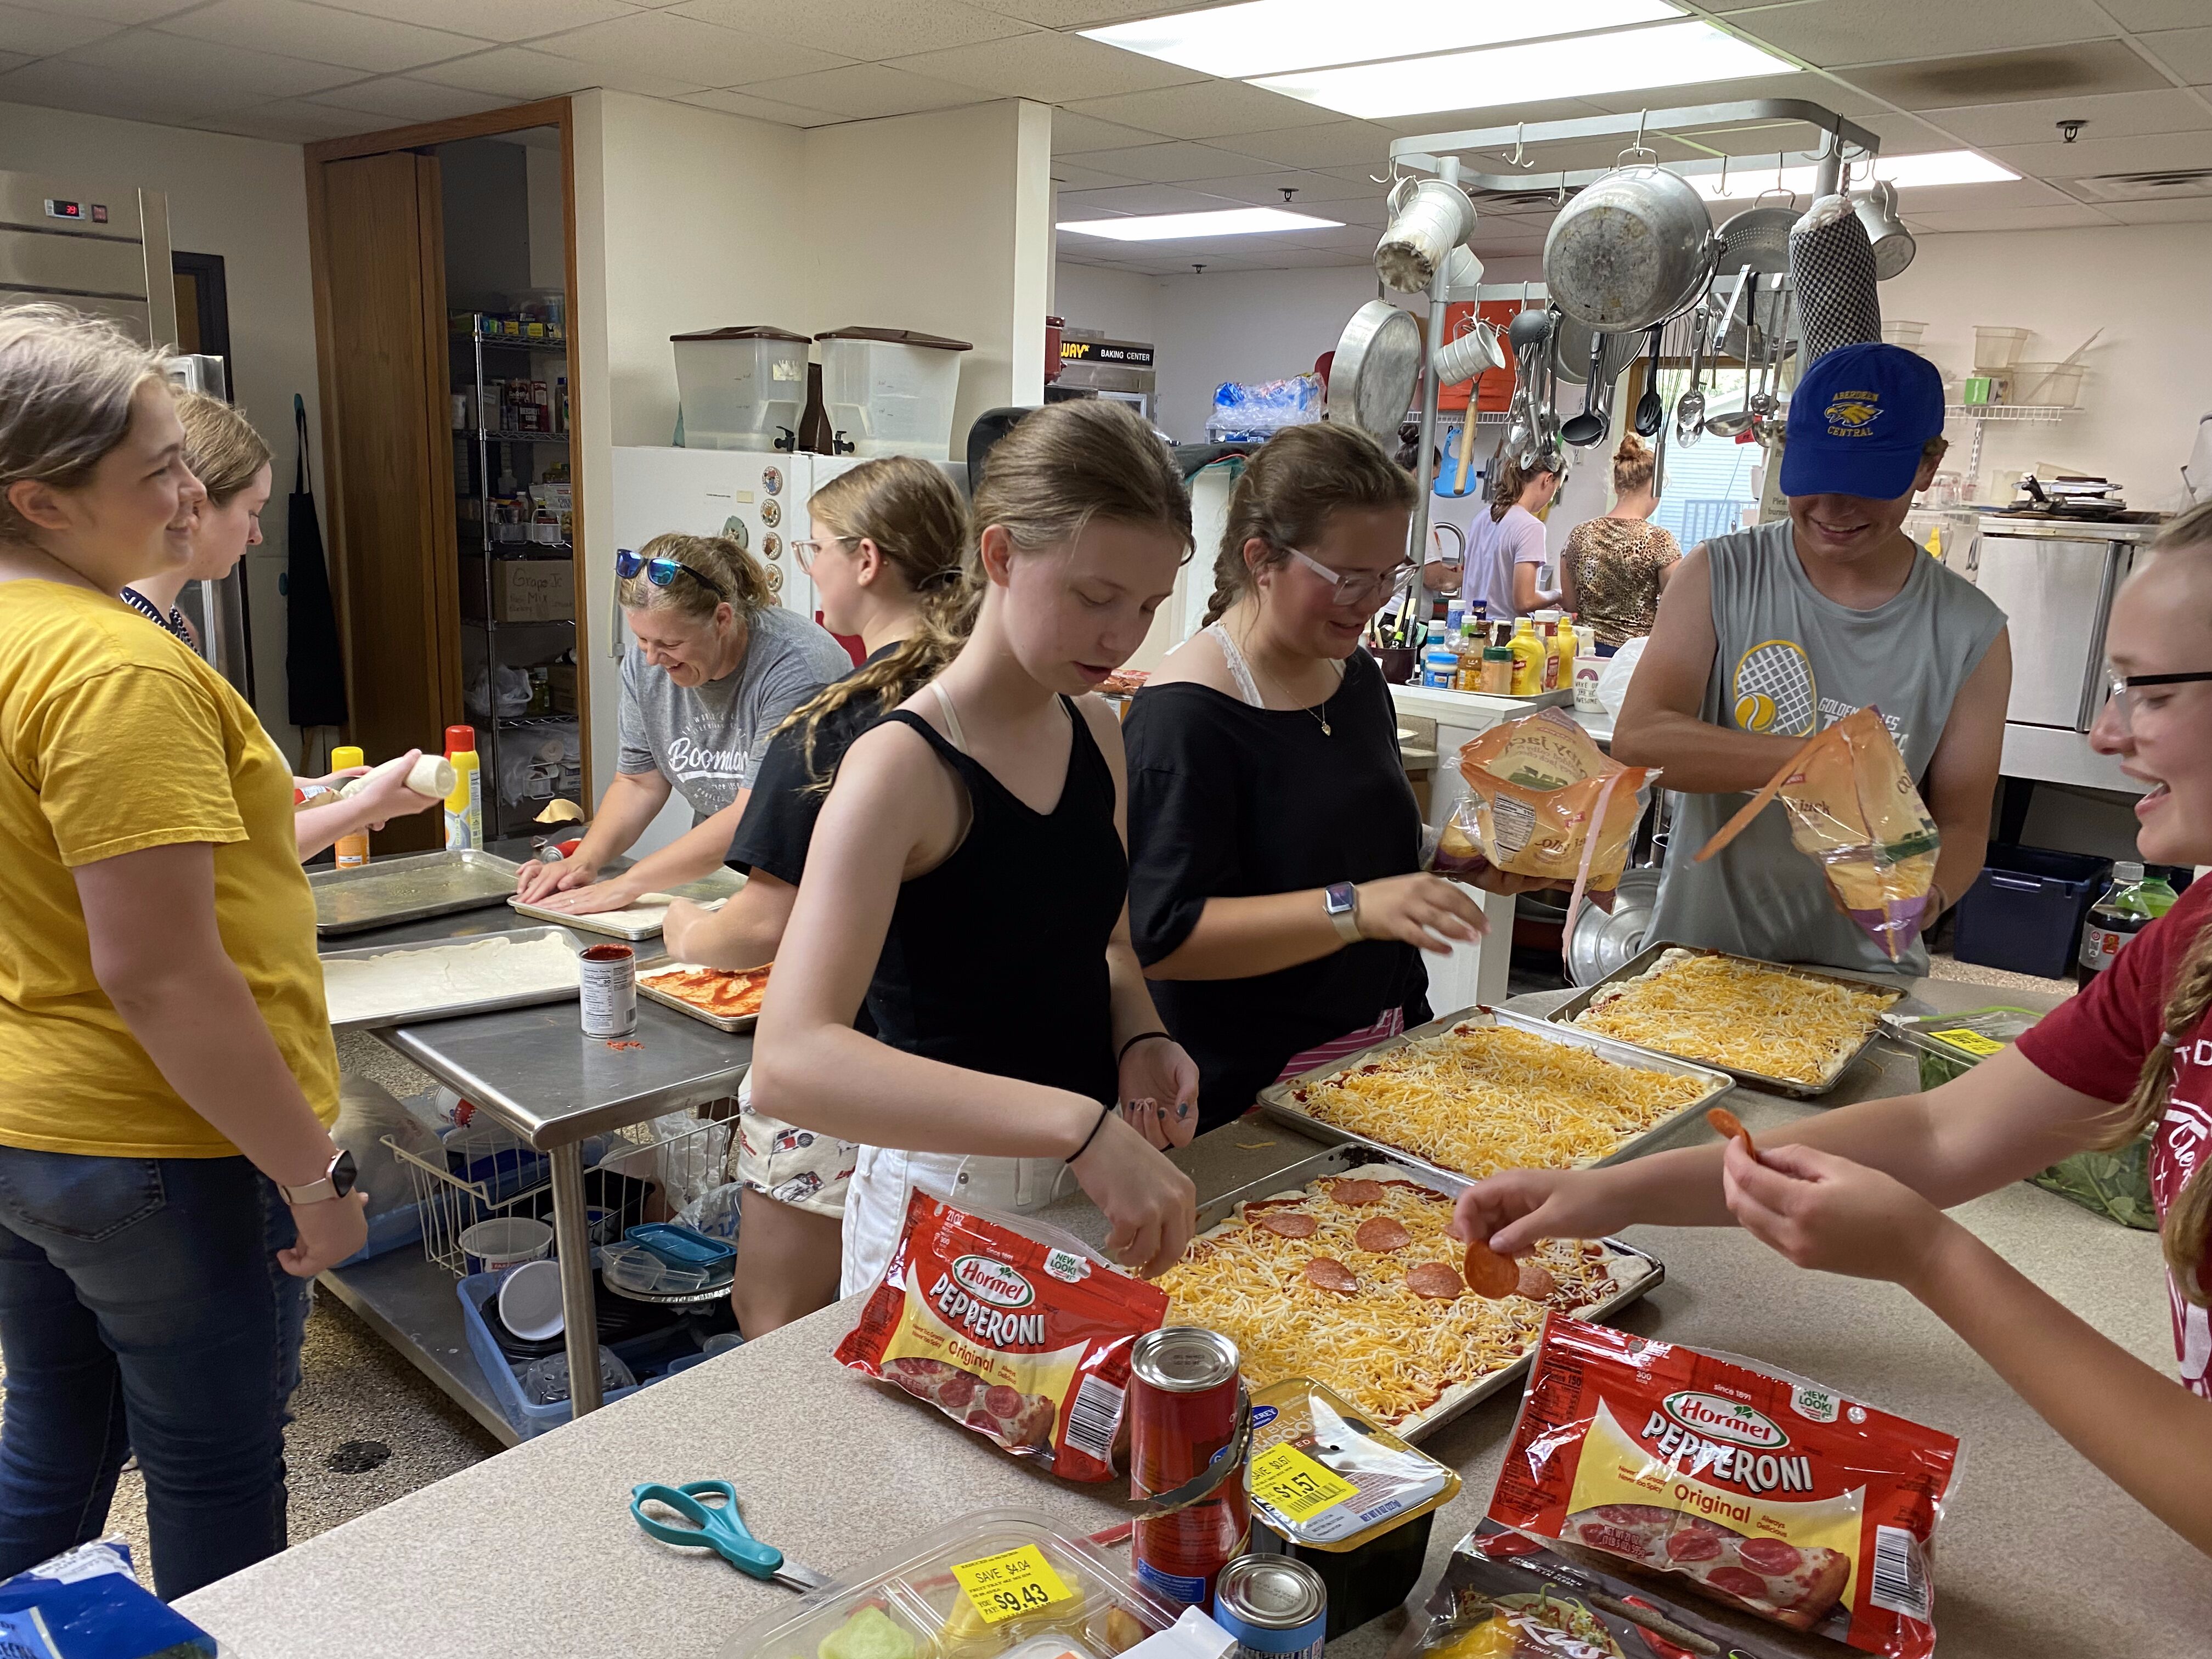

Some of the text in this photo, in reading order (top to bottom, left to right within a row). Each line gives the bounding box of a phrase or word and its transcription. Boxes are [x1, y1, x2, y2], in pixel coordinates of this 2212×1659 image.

[66, 205, 76, 215] 39
[1101, 349, 1150, 362] BAKING CENTER
[1832, 391, 1879, 402] ABERDEEN
[1827, 426, 1874, 437] CENTRAL
[512, 567, 548, 592] Grape
[527, 592, 548, 603] Mix
[1817, 697, 1860, 718] GOLDEN
[1056, 1252, 1076, 1266] NEW
[1050, 1260, 1077, 1276] LOOK!
[961, 1260, 1025, 1301] Hormel
[929, 1272, 1045, 1347] PEPPERONI
[948, 1340, 995, 1373] Original
[1567, 1373, 1582, 1386] 150
[1636, 1370, 1652, 1381] 300
[1713, 1384, 1752, 1401] since 1891
[1803, 1390, 1829, 1402] NEW
[1798, 1395, 1832, 1413] LOOK!
[1266, 1410, 1312, 1434] BELLA
[1680, 1397, 1771, 1441] Hormel
[1640, 1410, 1813, 1492] PEPPERONI
[1251, 1455, 1290, 1481] SAVE $0.67
[1273, 1471, 1321, 1498] $1.57
[1646, 1482, 1663, 1494] Spicy
[1674, 1483, 1751, 1523] Original
[1756, 1521, 1787, 1538] Delicious
[1761, 1514, 1786, 1529] Always
[975, 1559, 1031, 1584] SAVE $4.04
[978, 1599, 992, 1608] YOU
[993, 1583, 1049, 1611] $9.43
[1492, 1626, 1525, 1645] SWEET
[1524, 1643, 1551, 1655] LONG
